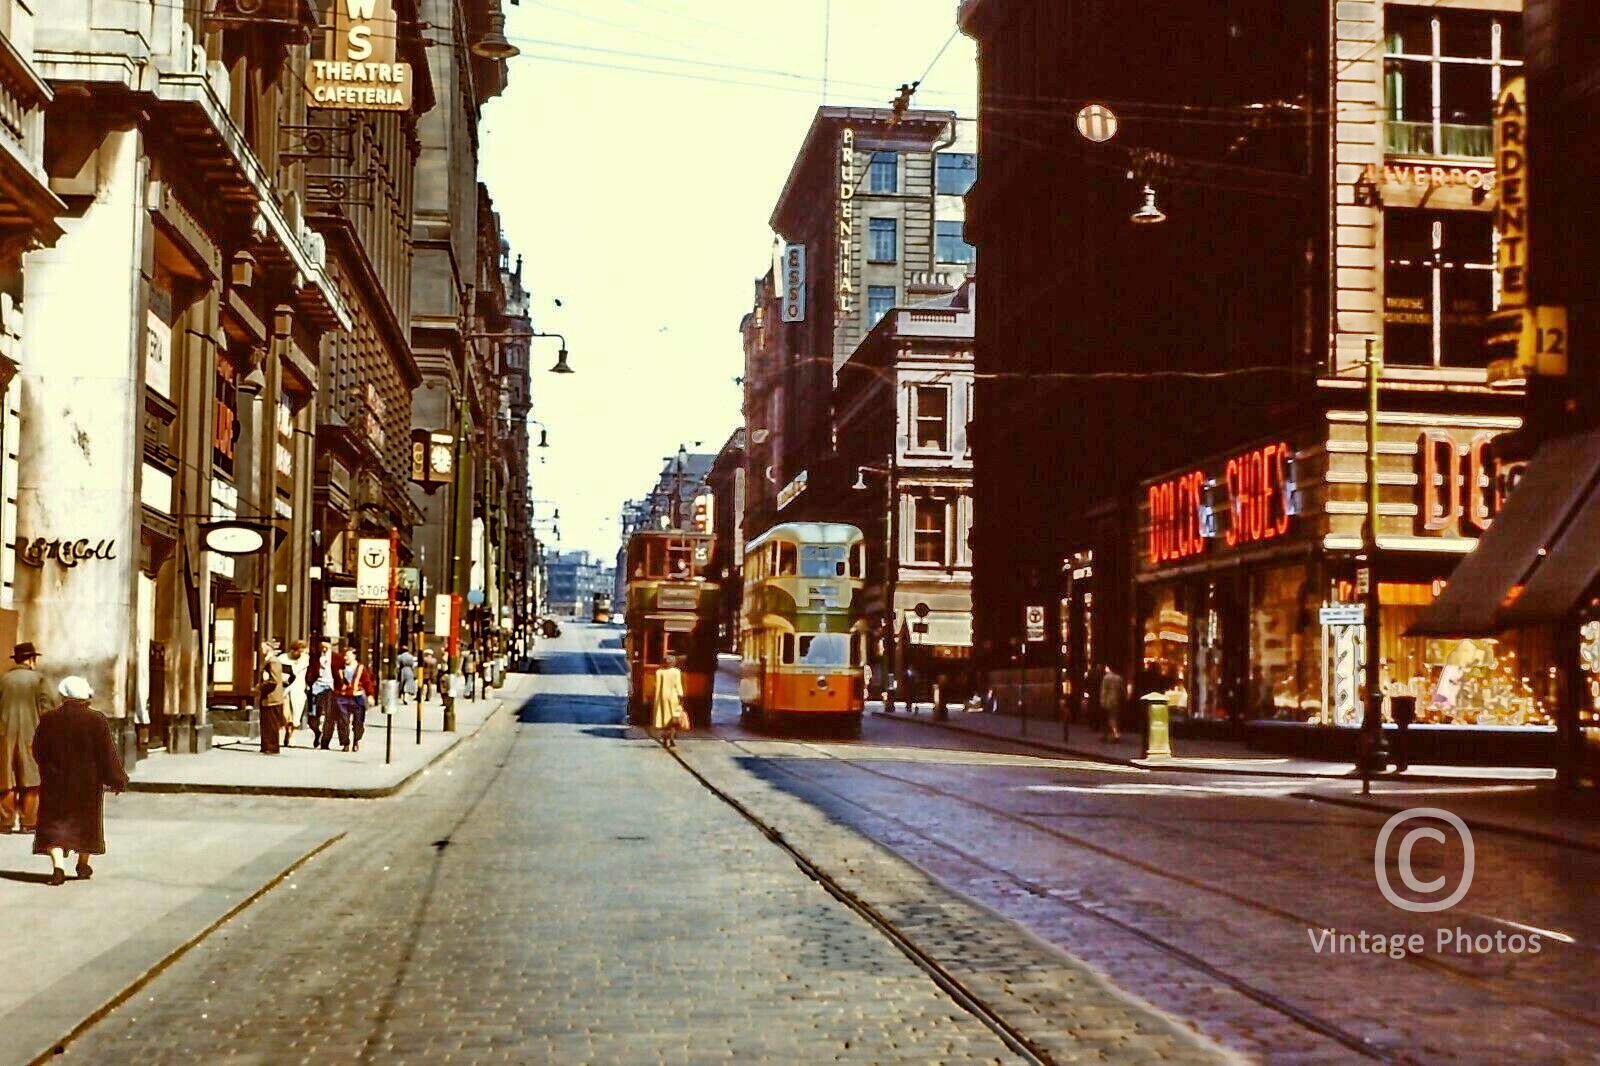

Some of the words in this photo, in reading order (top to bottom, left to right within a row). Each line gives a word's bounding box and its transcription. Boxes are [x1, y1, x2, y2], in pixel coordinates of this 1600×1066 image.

[313, 61, 404, 82] THEATRE
[313, 86, 404, 104] CAFETERIA
[840, 128, 854, 312] PRUDENTIAL
[788, 248, 800, 318] ESSO
[1536, 328, 1564, 354] 12
[1224, 441, 1291, 547] SHOES
[359, 585, 387, 597] STOP
